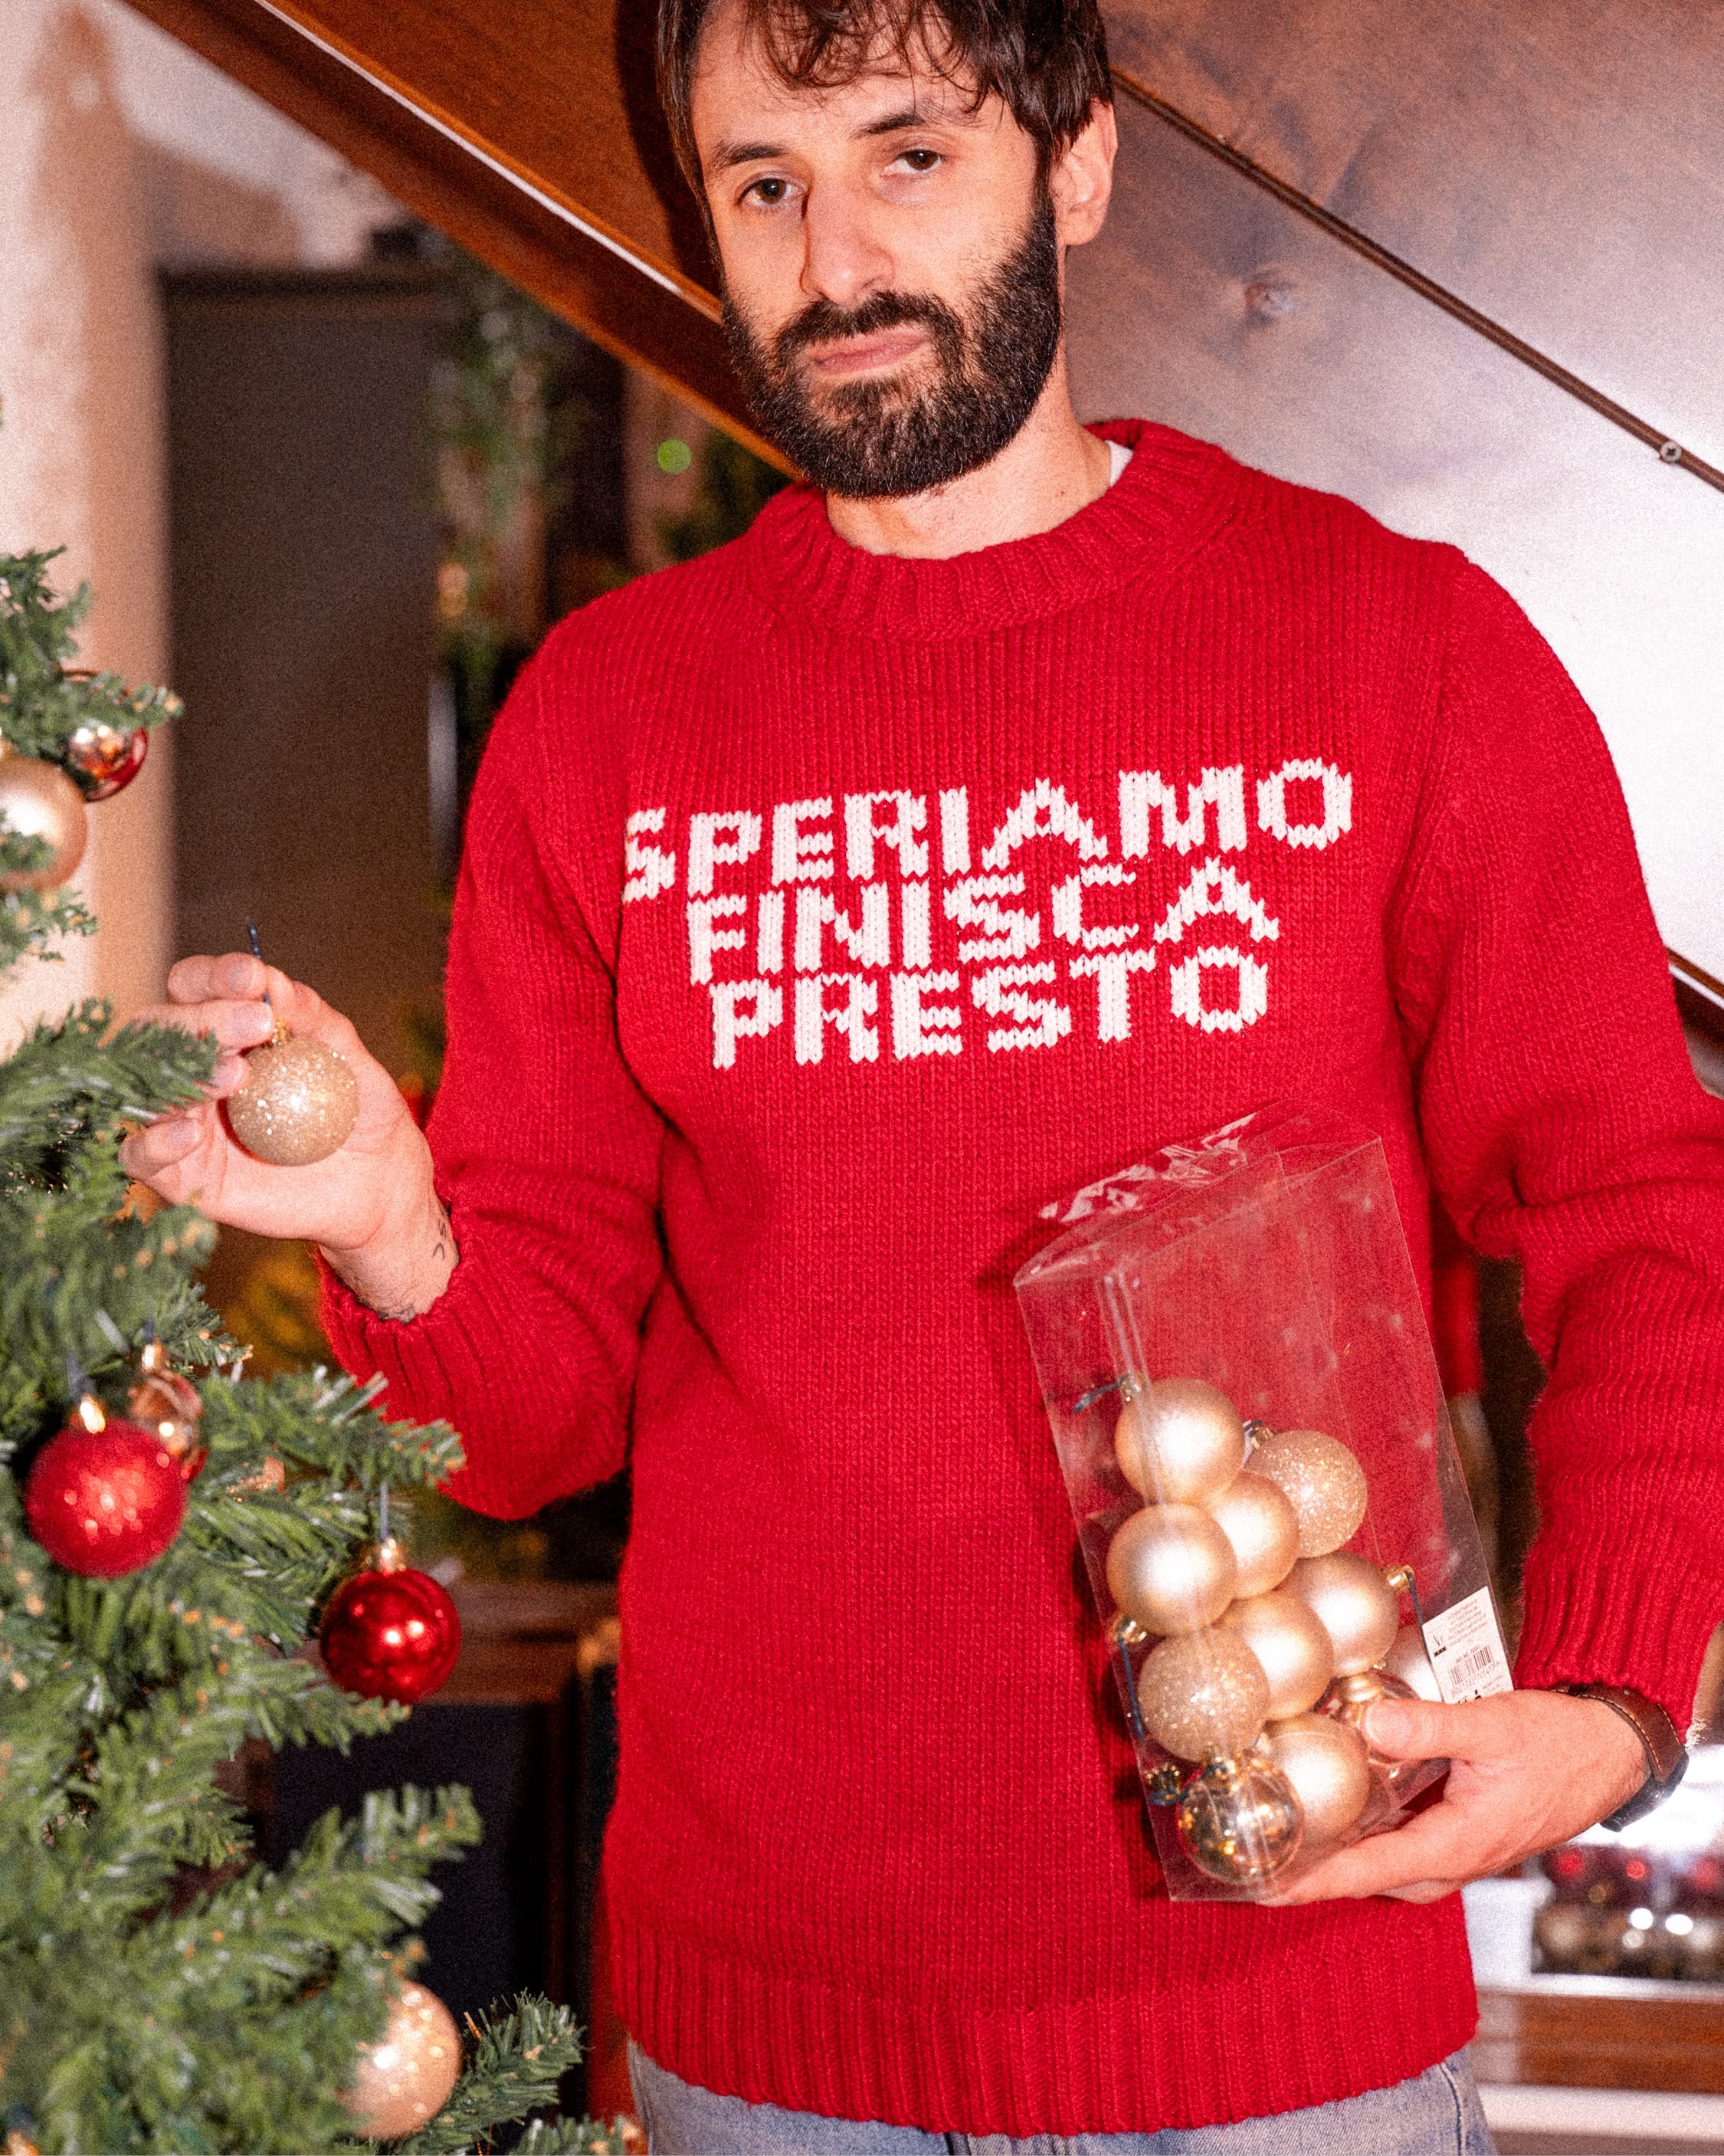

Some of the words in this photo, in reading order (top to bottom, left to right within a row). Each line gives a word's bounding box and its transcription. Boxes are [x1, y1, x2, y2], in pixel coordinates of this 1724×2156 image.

[623, 757, 1353, 903] SPERIAMO
[687, 855, 1280, 986] FINISCA
[710, 945, 1269, 1070] PRESTO
